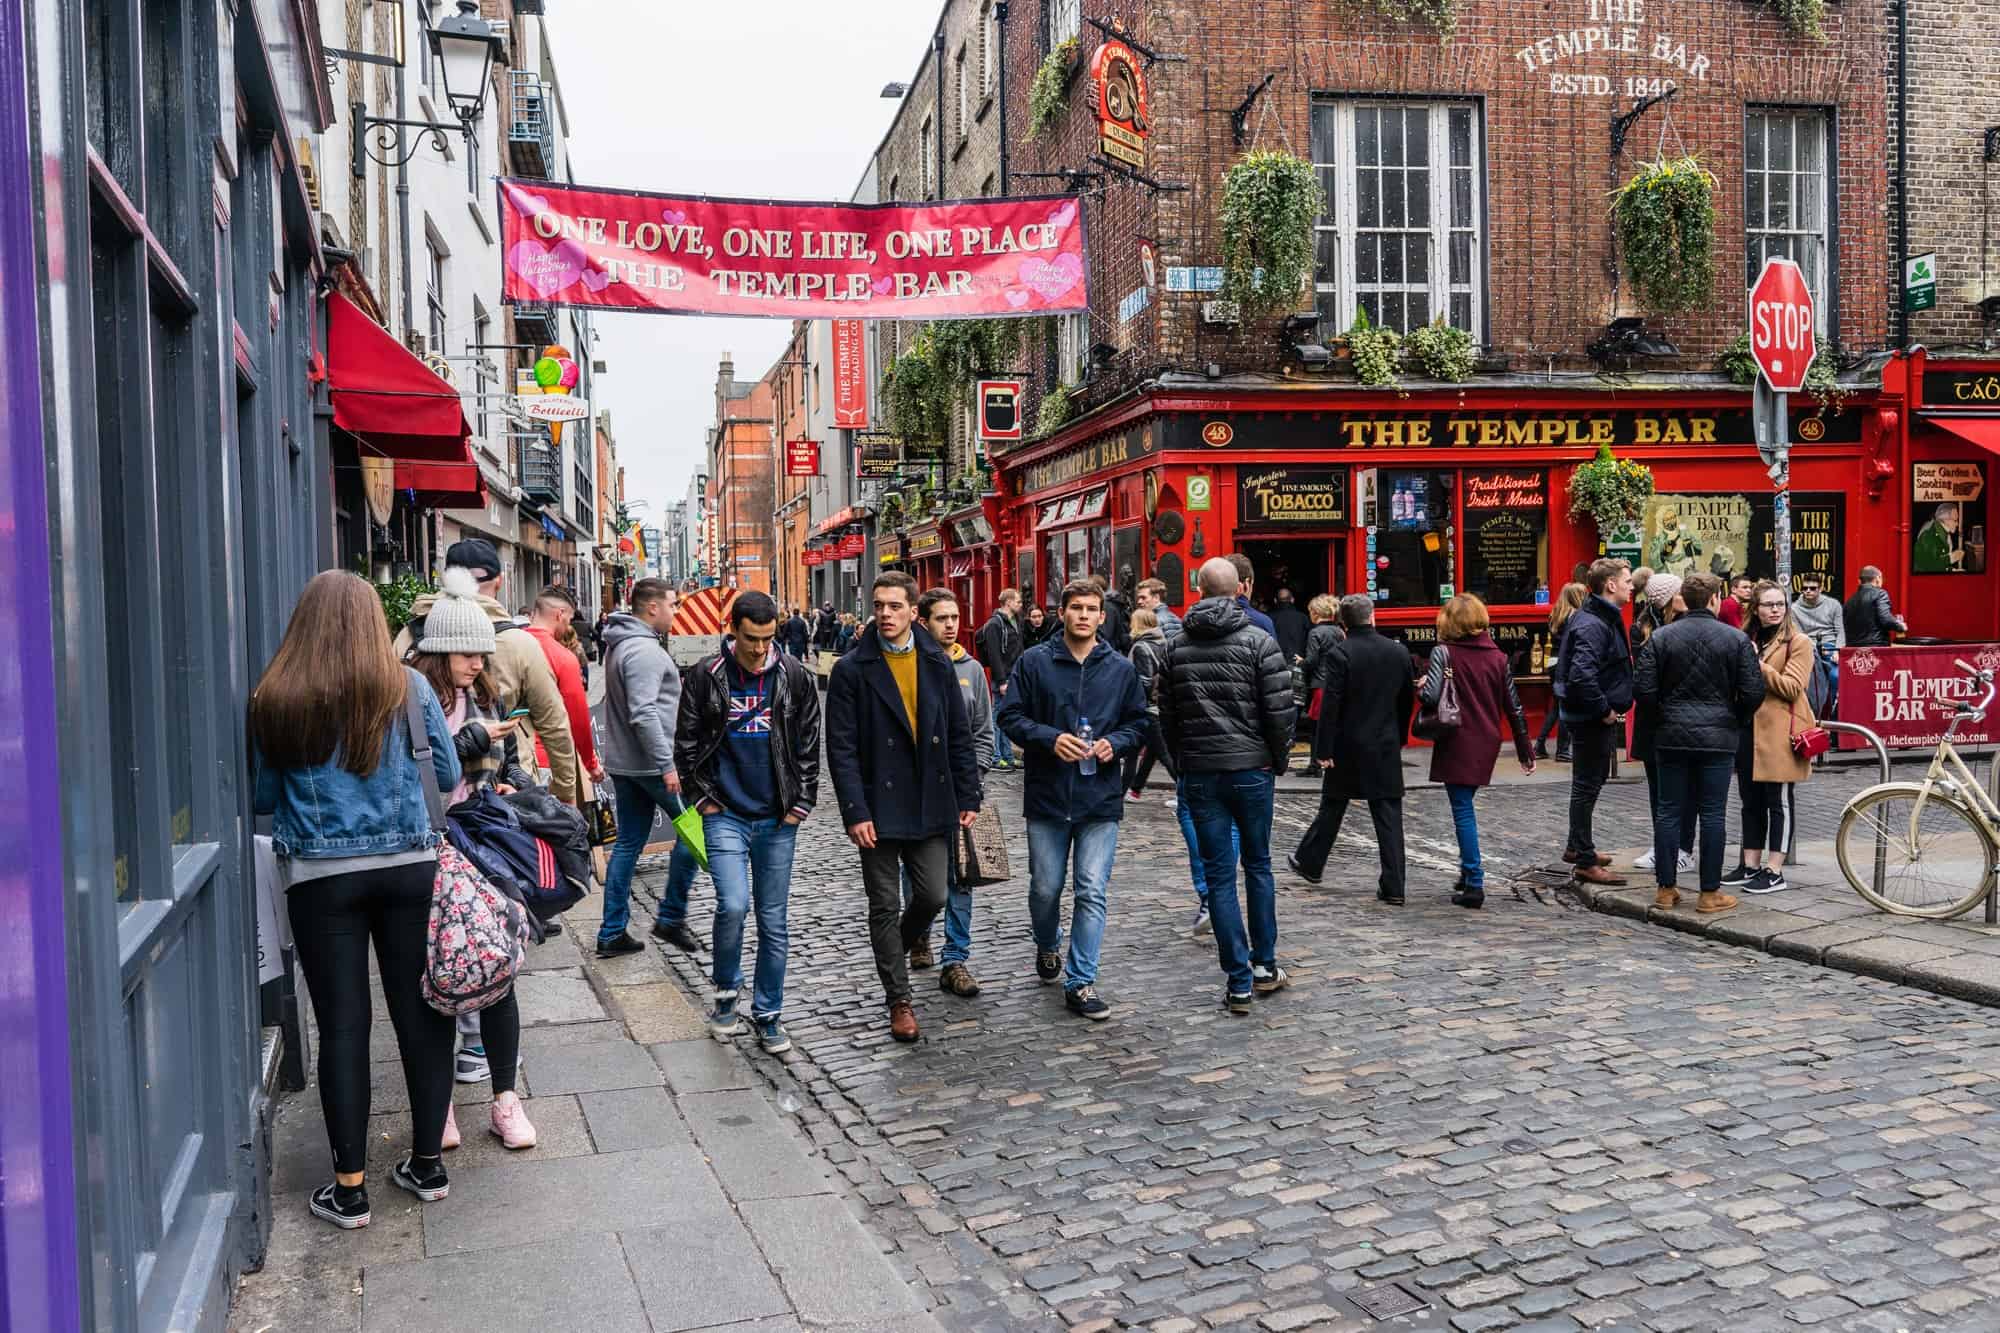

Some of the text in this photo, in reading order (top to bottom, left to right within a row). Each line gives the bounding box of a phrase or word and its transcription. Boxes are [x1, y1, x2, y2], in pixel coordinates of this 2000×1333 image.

[1588, 0, 1645, 23] THE
[1516, 27, 1710, 80] TEMPLE BAR
[1108, 142, 1122, 155] LIVE
[534, 212, 1060, 263] ONE LOVE, ONE LIFE, ONE PLACE
[599, 256, 685, 291] THE
[710, 268, 873, 302] TEMPLE
[893, 269, 976, 300] BAR
[1755, 299, 1811, 352] STOP
[839, 329, 850, 379] TEMPLE
[851, 339, 860, 385] TRADING
[840, 379, 851, 404] THE
[529, 404, 585, 417] Botticelli
[1207, 425, 1227, 440] 48
[1342, 417, 1718, 446] THE TEMPLE BAR
[1802, 423, 1819, 436] 48
[1033, 433, 1128, 489] THE TEMPLE BAR
[1916, 466, 1937, 477] Beer
[1938, 467, 1970, 478] Garden
[1299, 484, 1334, 492] SMOKING
[1468, 473, 1541, 492] Traditional
[1916, 479, 1953, 491] Smoking
[1255, 489, 1335, 517] TOBACCO
[1466, 491, 1544, 508] Irish Music
[1923, 490, 1944, 500] Area
[1675, 502, 1745, 516] TEMPLE
[1696, 517, 1731, 531] BAR
[1801, 511, 1830, 530] THE
[1765, 531, 1830, 551] EPEROR
[1812, 552, 1829, 571] OF
[1404, 628, 1435, 641] THE
[1500, 625, 1529, 640] BAR
[1874, 670, 1977, 699] THE TEMPLE
[1874, 691, 1927, 722] BAR
